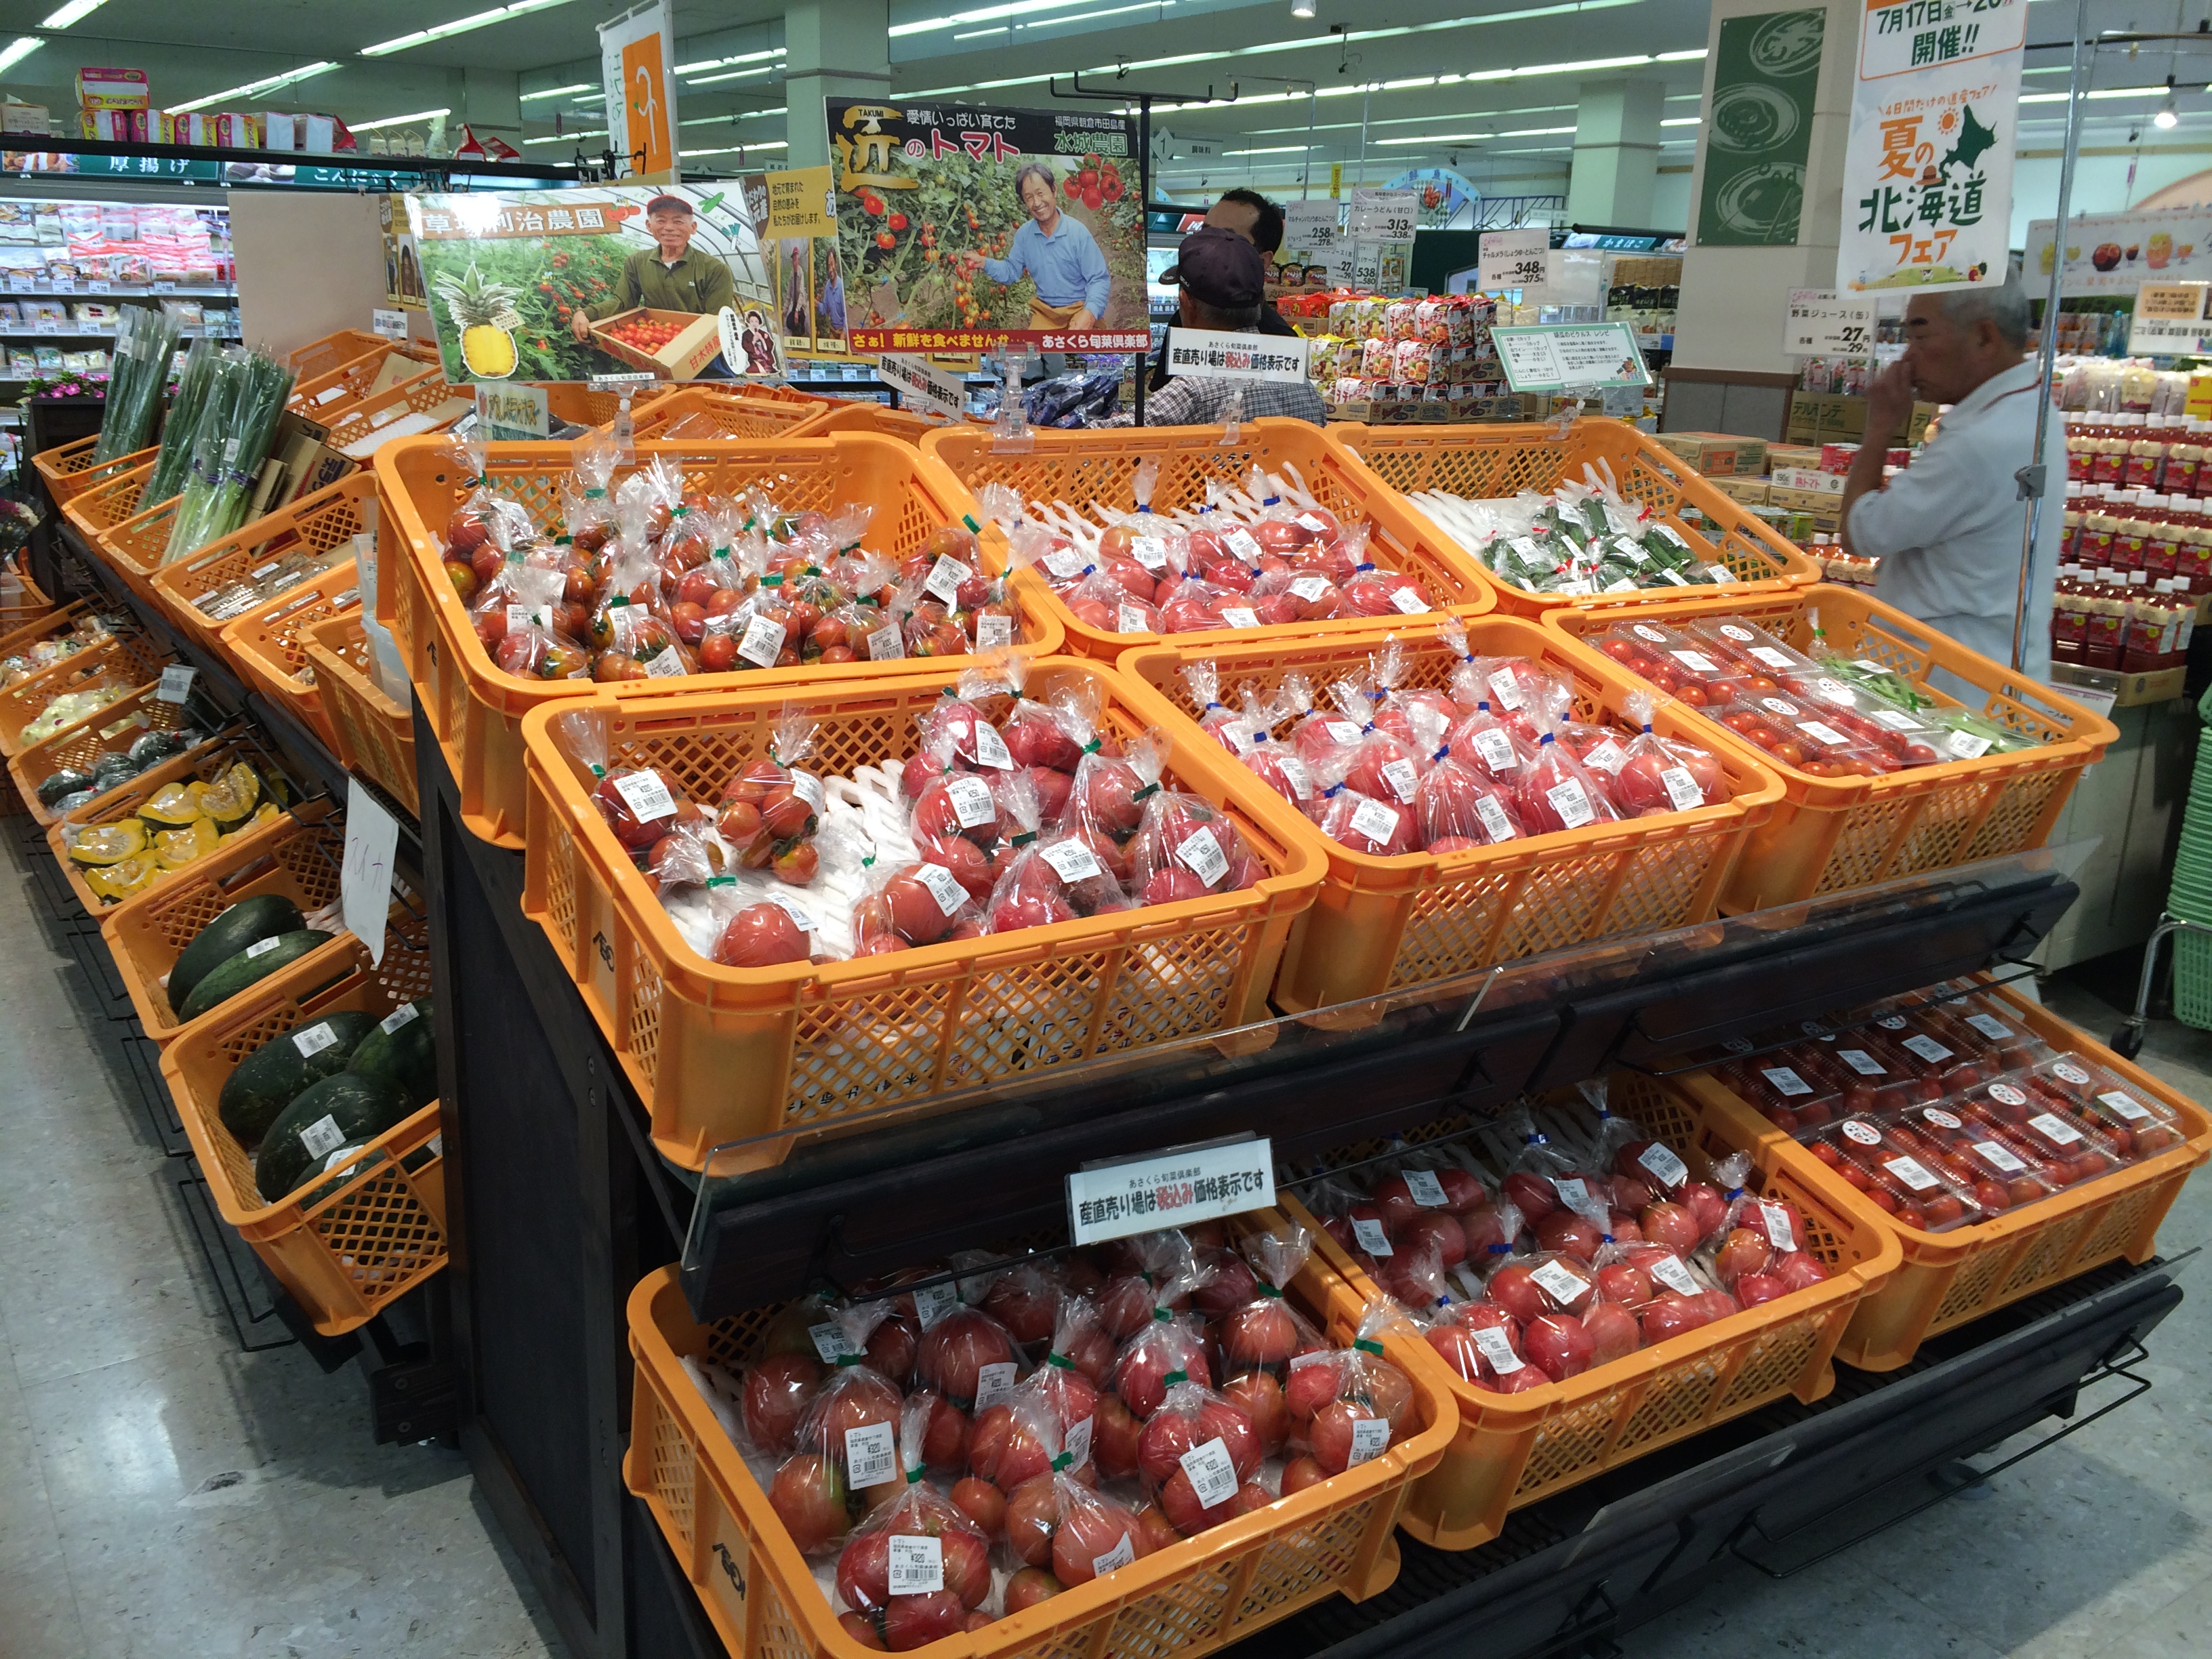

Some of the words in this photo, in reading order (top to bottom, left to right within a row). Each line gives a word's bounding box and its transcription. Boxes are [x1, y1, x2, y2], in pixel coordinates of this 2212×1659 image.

[1911, 24, 1980, 66] 開催!!
[858, 108, 884, 118] TAKUMI
[906, 109, 1016, 131] 愛情いっぱい育てた
[1054, 115, 1126, 131] 福岡県朝倉市田島産
[905, 128, 1020, 165] のトマト
[1054, 131, 1128, 157] 水城農園
[1877, 115, 1935, 181] 夏の
[110, 157, 190, 174] 厚揚げ
[314, 168, 398, 186] こんにゃく
[772, 181, 804, 196] 地元で育まれた
[773, 197, 800, 211] 自然の恵みを
[1858, 169, 1988, 234] 北海道
[1603, 238, 1644, 249] かまぼこ
[1889, 228, 1959, 266] フェア
[1356, 268, 1376, 276] 538
[1791, 309, 1870, 319] 野菜ジュース(缶)
[1042, 334, 1149, 348] あさくら旬菜倶楽部
[1172, 347, 1300, 372] 産直売り場は税込み価格表示です
[1128, 1166, 1202, 1189] あさくら旬菜倶楽部
[1078, 1168, 1265, 1227] 産直売り場は税込み価格表示です
